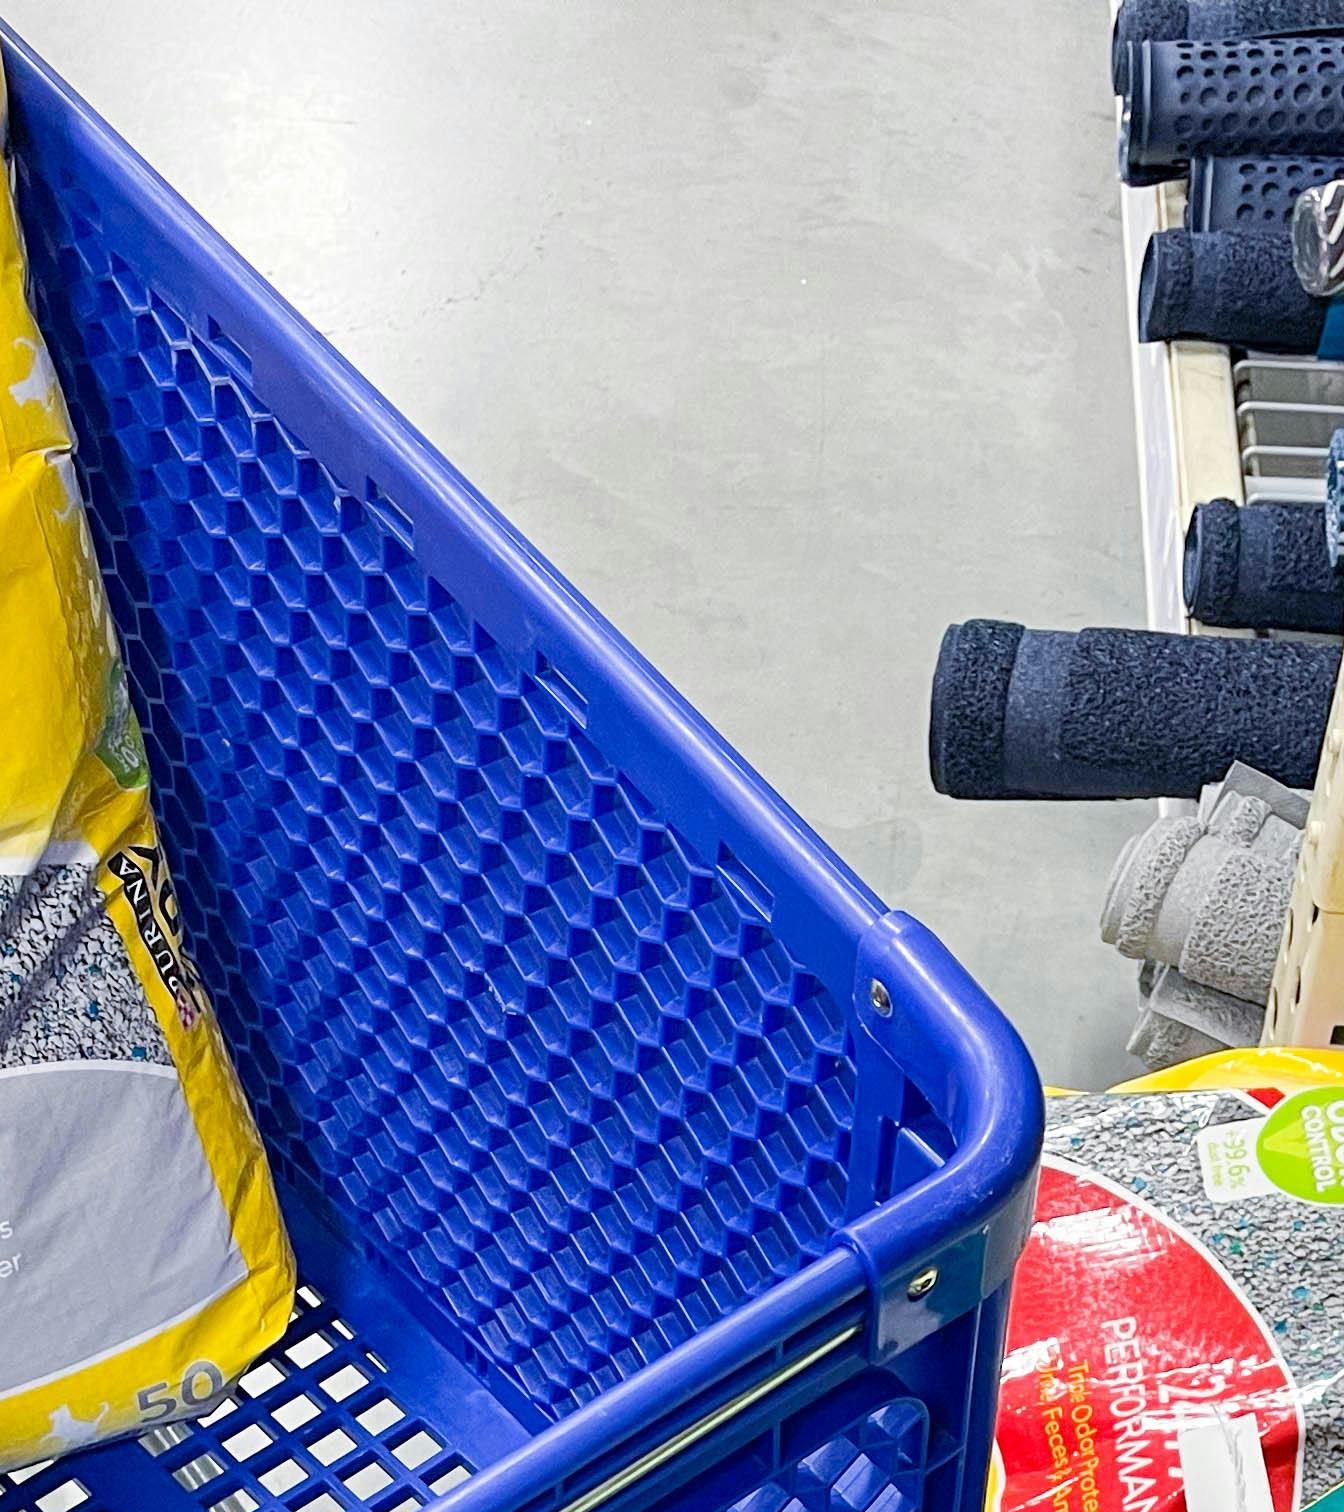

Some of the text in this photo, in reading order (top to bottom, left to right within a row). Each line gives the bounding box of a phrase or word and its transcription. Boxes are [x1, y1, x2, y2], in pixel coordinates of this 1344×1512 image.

[1301, 1104, 1337, 1194] CONTROL
[136, 1359, 224, 1424] 50
[1041, 1406, 1070, 1467] Feces
[1071, 1404, 1098, 1457] Odor
